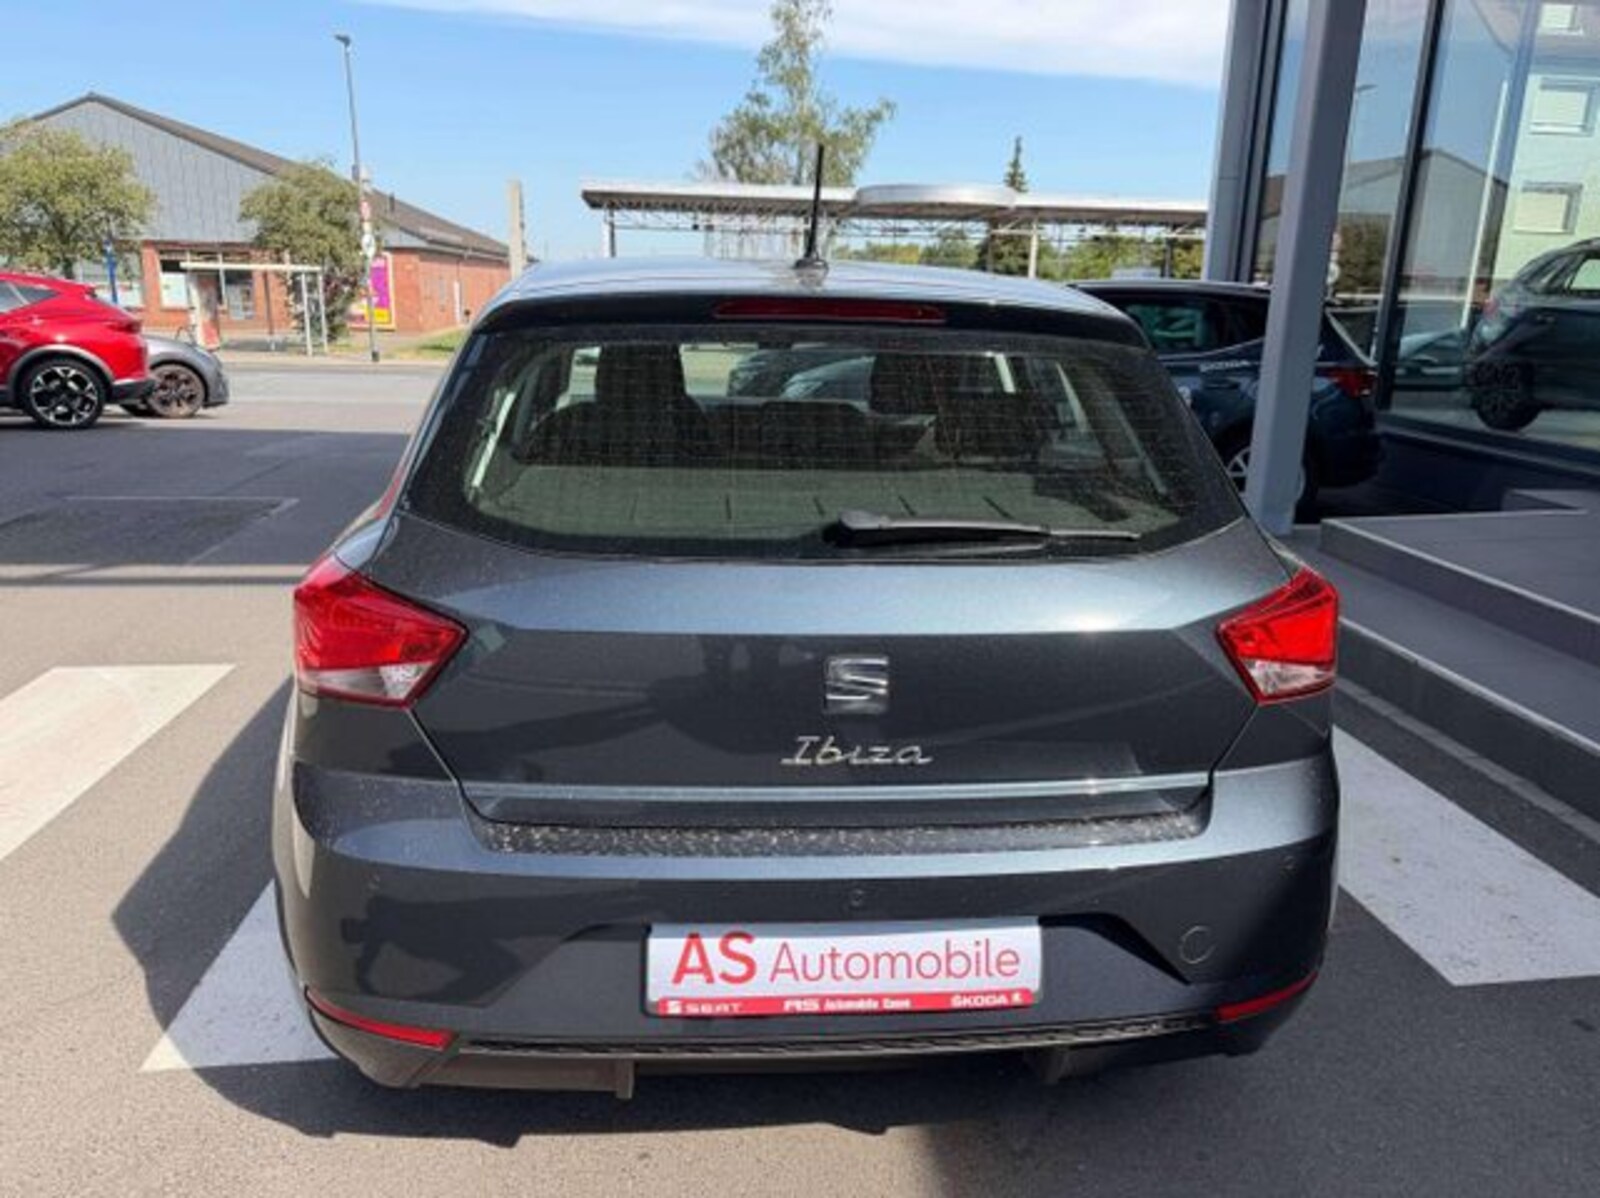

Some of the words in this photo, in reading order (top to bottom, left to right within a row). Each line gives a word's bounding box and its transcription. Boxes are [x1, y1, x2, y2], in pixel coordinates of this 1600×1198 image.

[780, 735, 933, 765] Ibiza
[672, 931, 758, 985] AS
[770, 939, 1021, 983] Automobile
